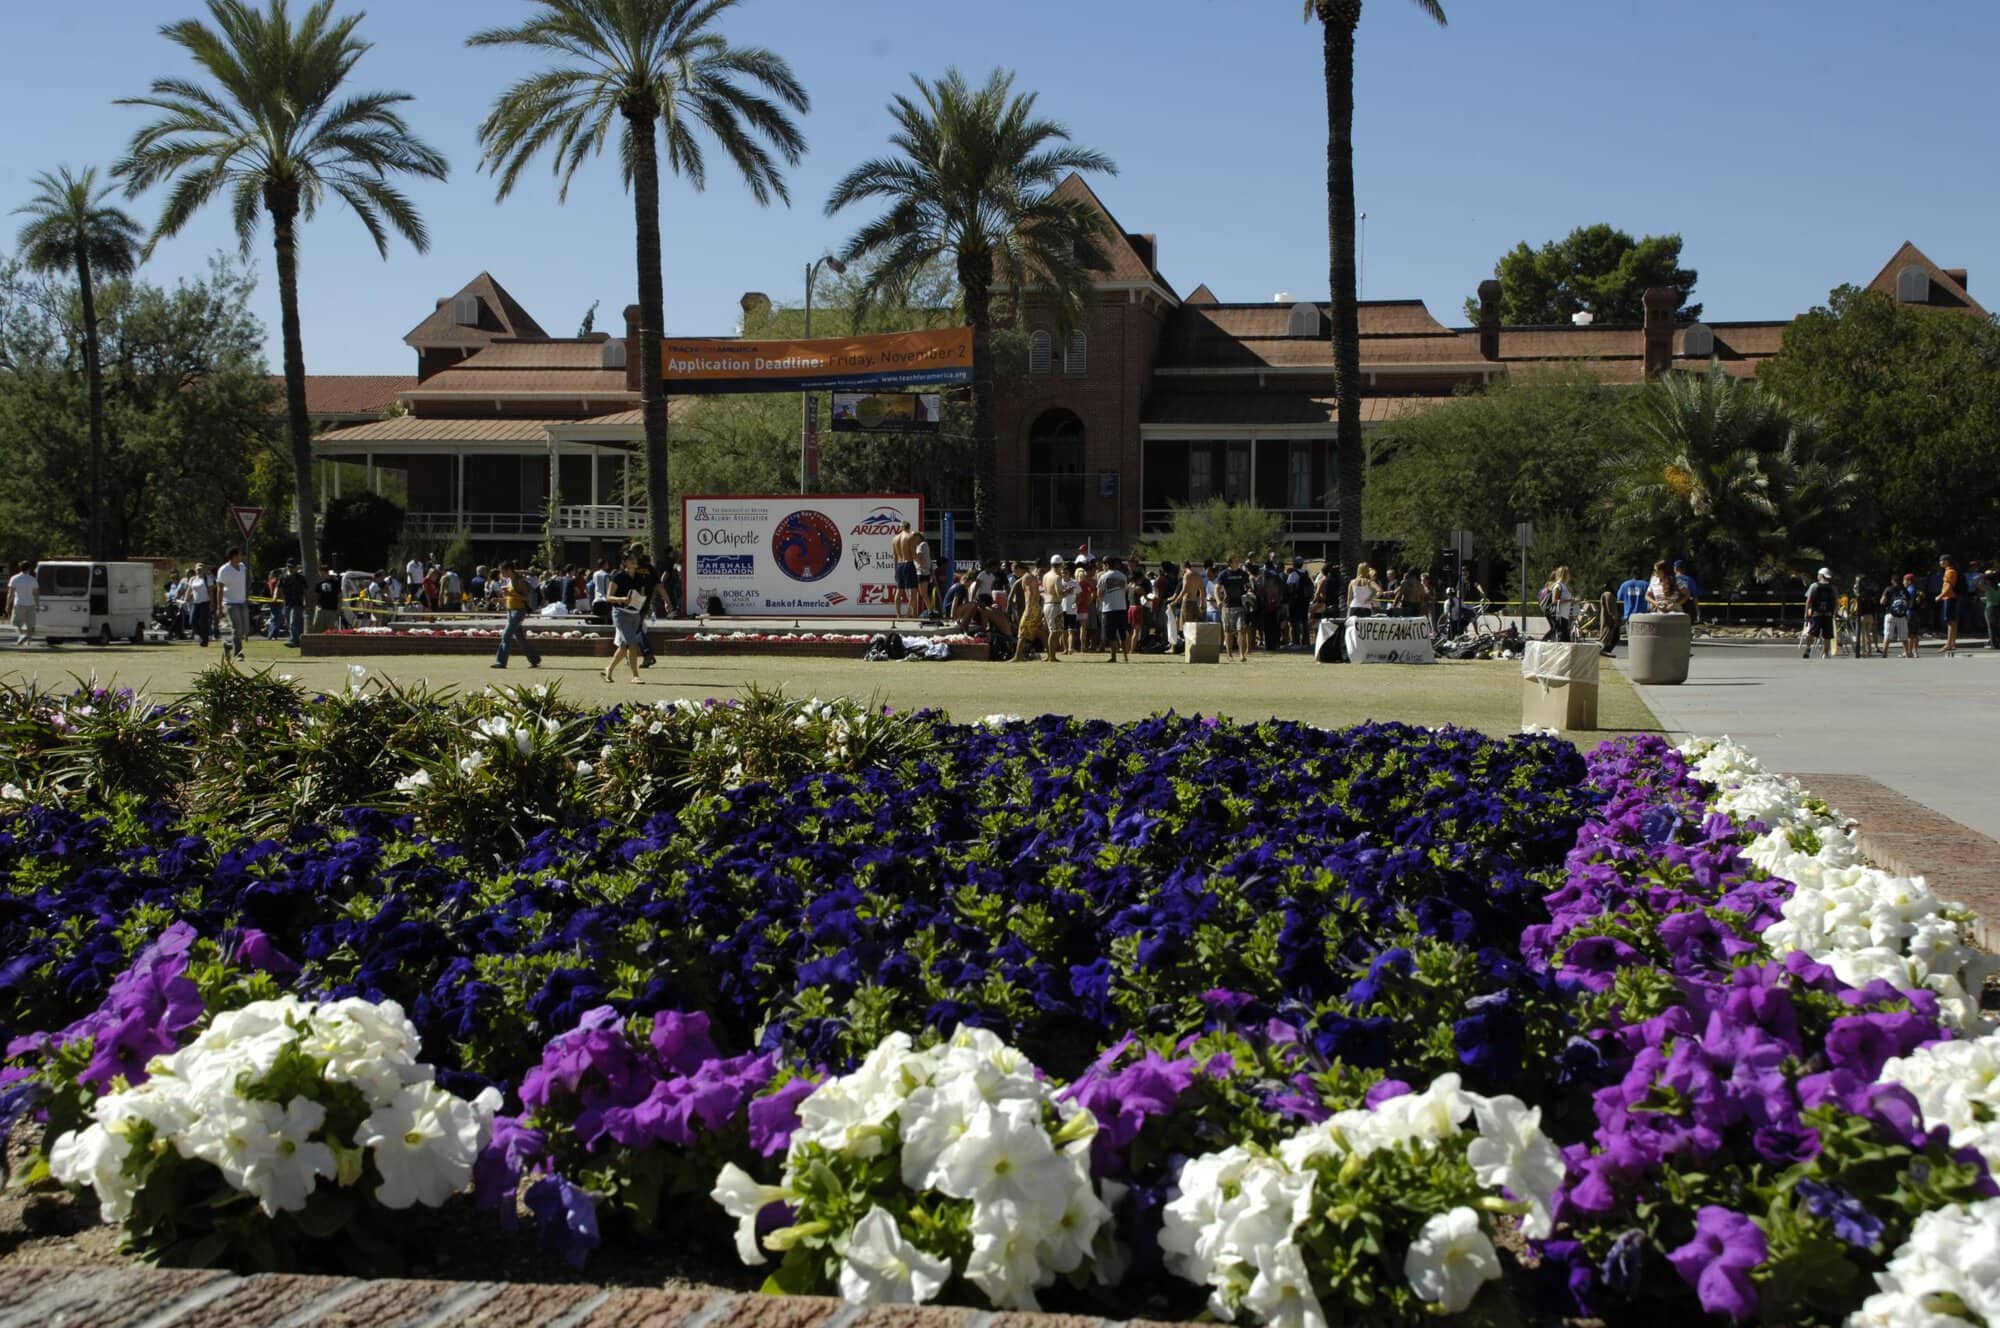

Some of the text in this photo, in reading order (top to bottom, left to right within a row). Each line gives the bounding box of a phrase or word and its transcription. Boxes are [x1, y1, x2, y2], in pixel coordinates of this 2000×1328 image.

[668, 358, 750, 373] Application
[755, 356, 824, 370] Deadline:
[880, 348, 955, 364] November
[958, 345, 967, 358] 2
[714, 529, 759, 548] Chipotle
[765, 600, 786, 608] Bank
[796, 600, 830, 608] America
